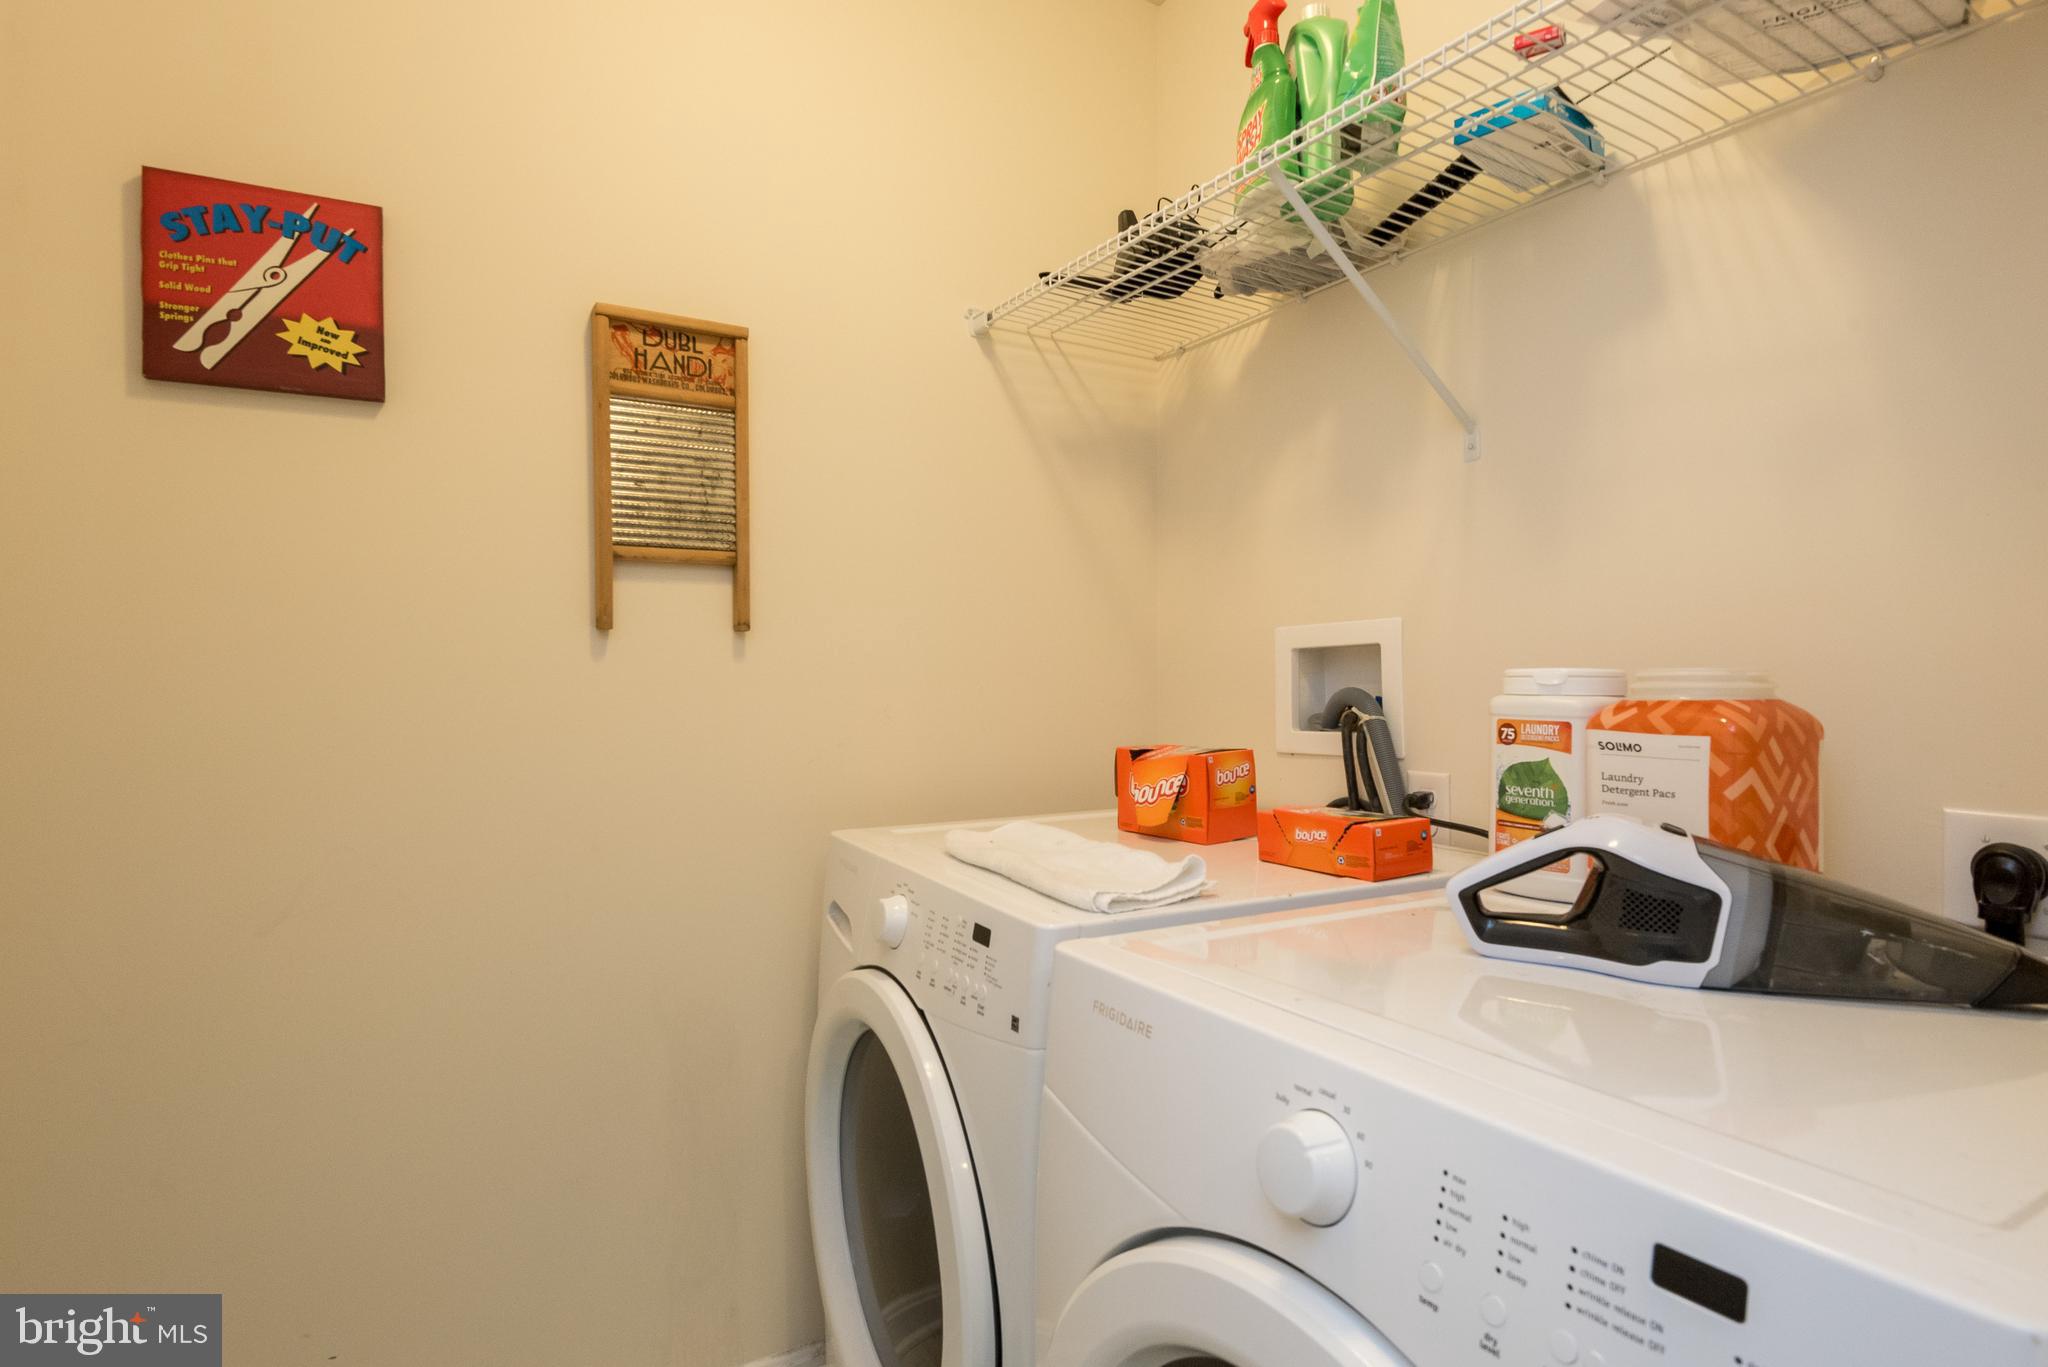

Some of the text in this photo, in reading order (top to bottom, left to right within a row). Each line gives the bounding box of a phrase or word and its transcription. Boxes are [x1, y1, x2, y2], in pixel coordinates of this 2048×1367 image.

[160, 203, 368, 264] STAY-PUT
[159, 250, 237, 267] Clothes Pins that
[159, 260, 205, 274] Grip Tight
[159, 280, 212, 294] Solid Wood
[160, 301, 200, 313] Stronger
[160, 312, 194, 324] Springs
[316, 325, 340, 340] New
[642, 327, 704, 354] DUBL
[297, 335, 349, 360] Improved
[634, 347, 713, 380] HANDI
[1500, 722, 1561, 740] 75 LAUNDRY
[1597, 740, 1642, 753] SOLIMO
[1215, 762, 1251, 786] bounce
[1601, 771, 1644, 785] Laundry
[1505, 784, 1555, 799] seventh
[1601, 784, 1677, 799] Detergent Pacs
[1505, 794, 1554, 808] generation
[1294, 828, 1329, 843] bounce
[1092, 999, 1153, 1040] FRIGIDAIRE
[1447, 1206, 1472, 1223] normal
[1512, 1217, 1530, 1232] high
[1510, 1235, 1538, 1254] normal
[1581, 1250, 1609, 1268] chime
[1579, 1268, 1606, 1286] chime
[1578, 1287, 1610, 1308] wrinkle
[1613, 1304, 1648, 1325] release
[1576, 1306, 1609, 1328] wrinkle
[1611, 1322, 1645, 1345] release
